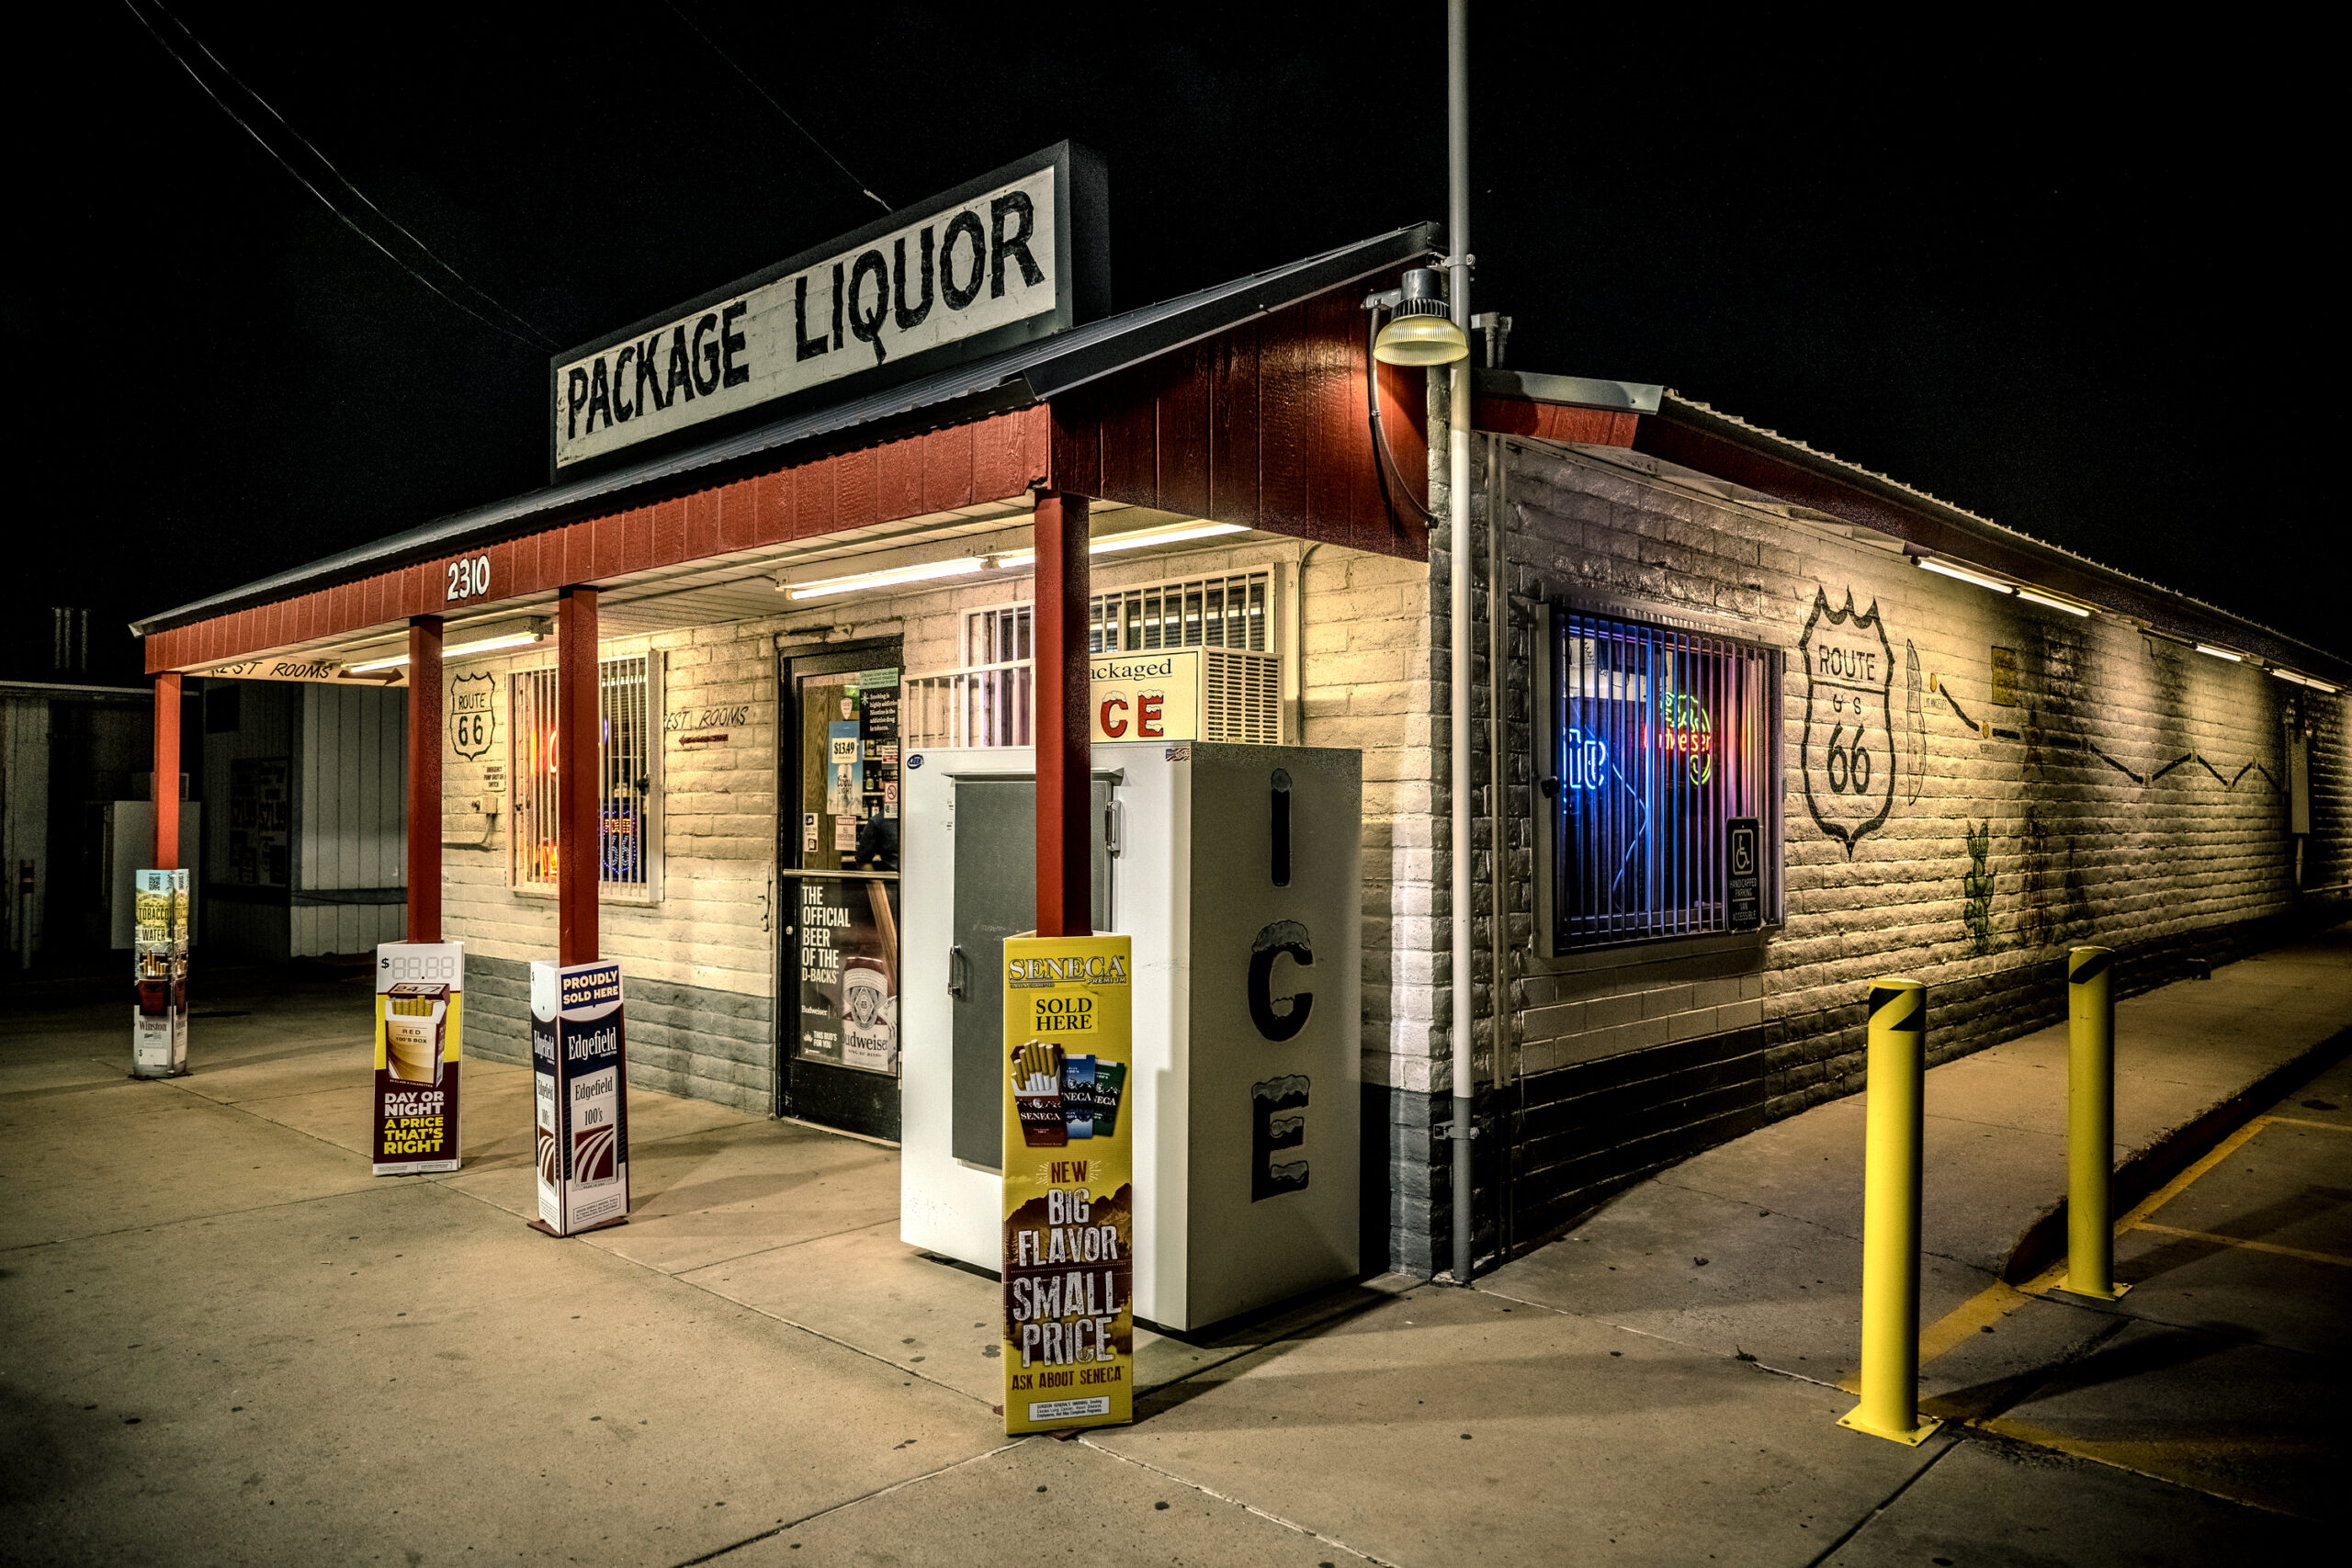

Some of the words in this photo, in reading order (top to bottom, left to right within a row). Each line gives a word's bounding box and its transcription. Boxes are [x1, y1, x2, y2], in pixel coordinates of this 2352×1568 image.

[568, 300, 750, 440] PACKAGE
[796, 190, 1046, 366] LIQUOR
[447, 554, 491, 602] 2310
[270, 662, 333, 679] ROOMS
[1091, 659, 1171, 682] ackaged
[1819, 645, 1875, 681] ROUTE
[459, 693, 485, 710] ROUTE
[699, 705, 750, 728] ROOMS
[1101, 689, 1163, 738] CE
[458, 715, 483, 746] 66
[833, 741, 855, 754] $13.49
[1827, 720, 1871, 795] 66
[1729, 878, 1757, 888] HANDICAPPED
[1735, 888, 1753, 897] PARKING
[802, 886, 823, 905] THE
[139, 908, 169, 920] TOBACCO
[1733, 910, 1757, 921] ACCESSIBLE
[1739, 902, 1748, 910] VAN
[803, 907, 851, 927] OFFICIAL
[141, 930, 166, 941] WATER
[802, 927, 831, 947] BEER
[802, 947, 816, 966] OF
[818, 948, 840, 968] THE
[802, 967, 838, 984] D-BACKS
[1009, 955, 1126, 980] SENECA
[562, 970, 618, 991] PROUDLY
[1087, 976, 1126, 985] PREMIUM
[1248, 767, 1315, 1204] ICE
[562, 990, 592, 1005] SOLD
[594, 985, 618, 999] HERE
[801, 1005, 828, 1016] Budweiser
[1035, 998, 1091, 1014] SOLD
[139, 1020, 167, 1032] Winston
[1035, 1014, 1091, 1031] HERE
[568, 1026, 617, 1061] Edgefield
[813, 1031, 823, 1039] THIS
[823, 1040, 832, 1048] YOU
[385, 1091, 418, 1103] DAY
[421, 1090, 445, 1102] OR
[575, 1076, 613, 1101] Edgefield
[1062, 1091, 1091, 1101] NECA
[384, 1101, 445, 1117] NIGHT
[584, 1107, 603, 1126] 100's
[1020, 1111, 1061, 1121] SENECA
[384, 1119, 396, 1129] A
[400, 1116, 444, 1129] PRICE
[384, 1127, 444, 1141] THAT'S
[383, 1138, 444, 1155] RIGHT
[1051, 1160, 1087, 1183] NEW
[1048, 1188, 1090, 1225] BIG
[1018, 1225, 1118, 1267] FLAVOR
[1012, 1270, 1123, 1322] SMALL
[1022, 1316, 1115, 1369] PRICE
[1012, 1374, 1033, 1391] ASK
[1039, 1371, 1075, 1388] ABOUT
[1080, 1365, 1122, 1385] SENECA
